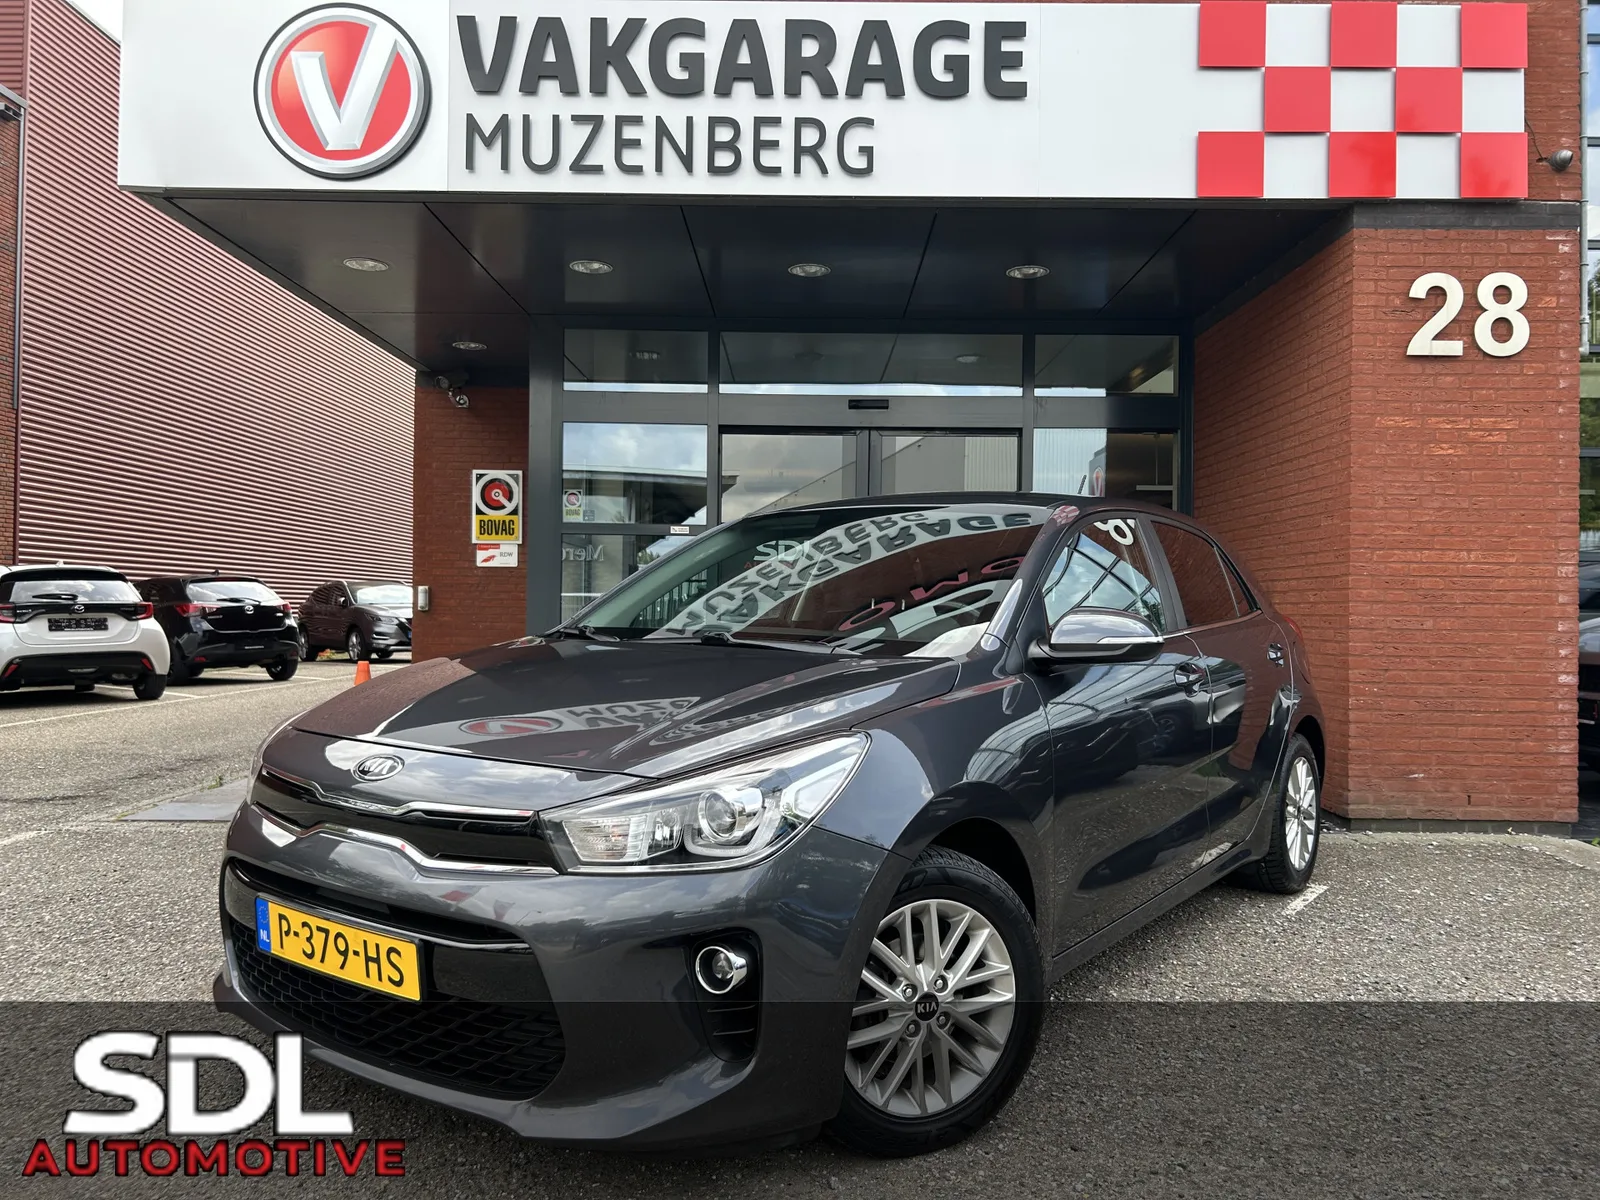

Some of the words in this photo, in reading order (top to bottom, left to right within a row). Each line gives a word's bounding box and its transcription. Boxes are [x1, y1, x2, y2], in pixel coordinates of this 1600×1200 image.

[457, 15, 1028, 99] VAKGARAGE
[465, 113, 874, 177] MUZENBERG
[1406, 272, 1531, 358] 28
[479, 519, 515, 536] BOVAG
[260, 929, 270, 942] NL
[278, 912, 405, 988] P-379-HS
[917, 1001, 938, 1014] KIA
